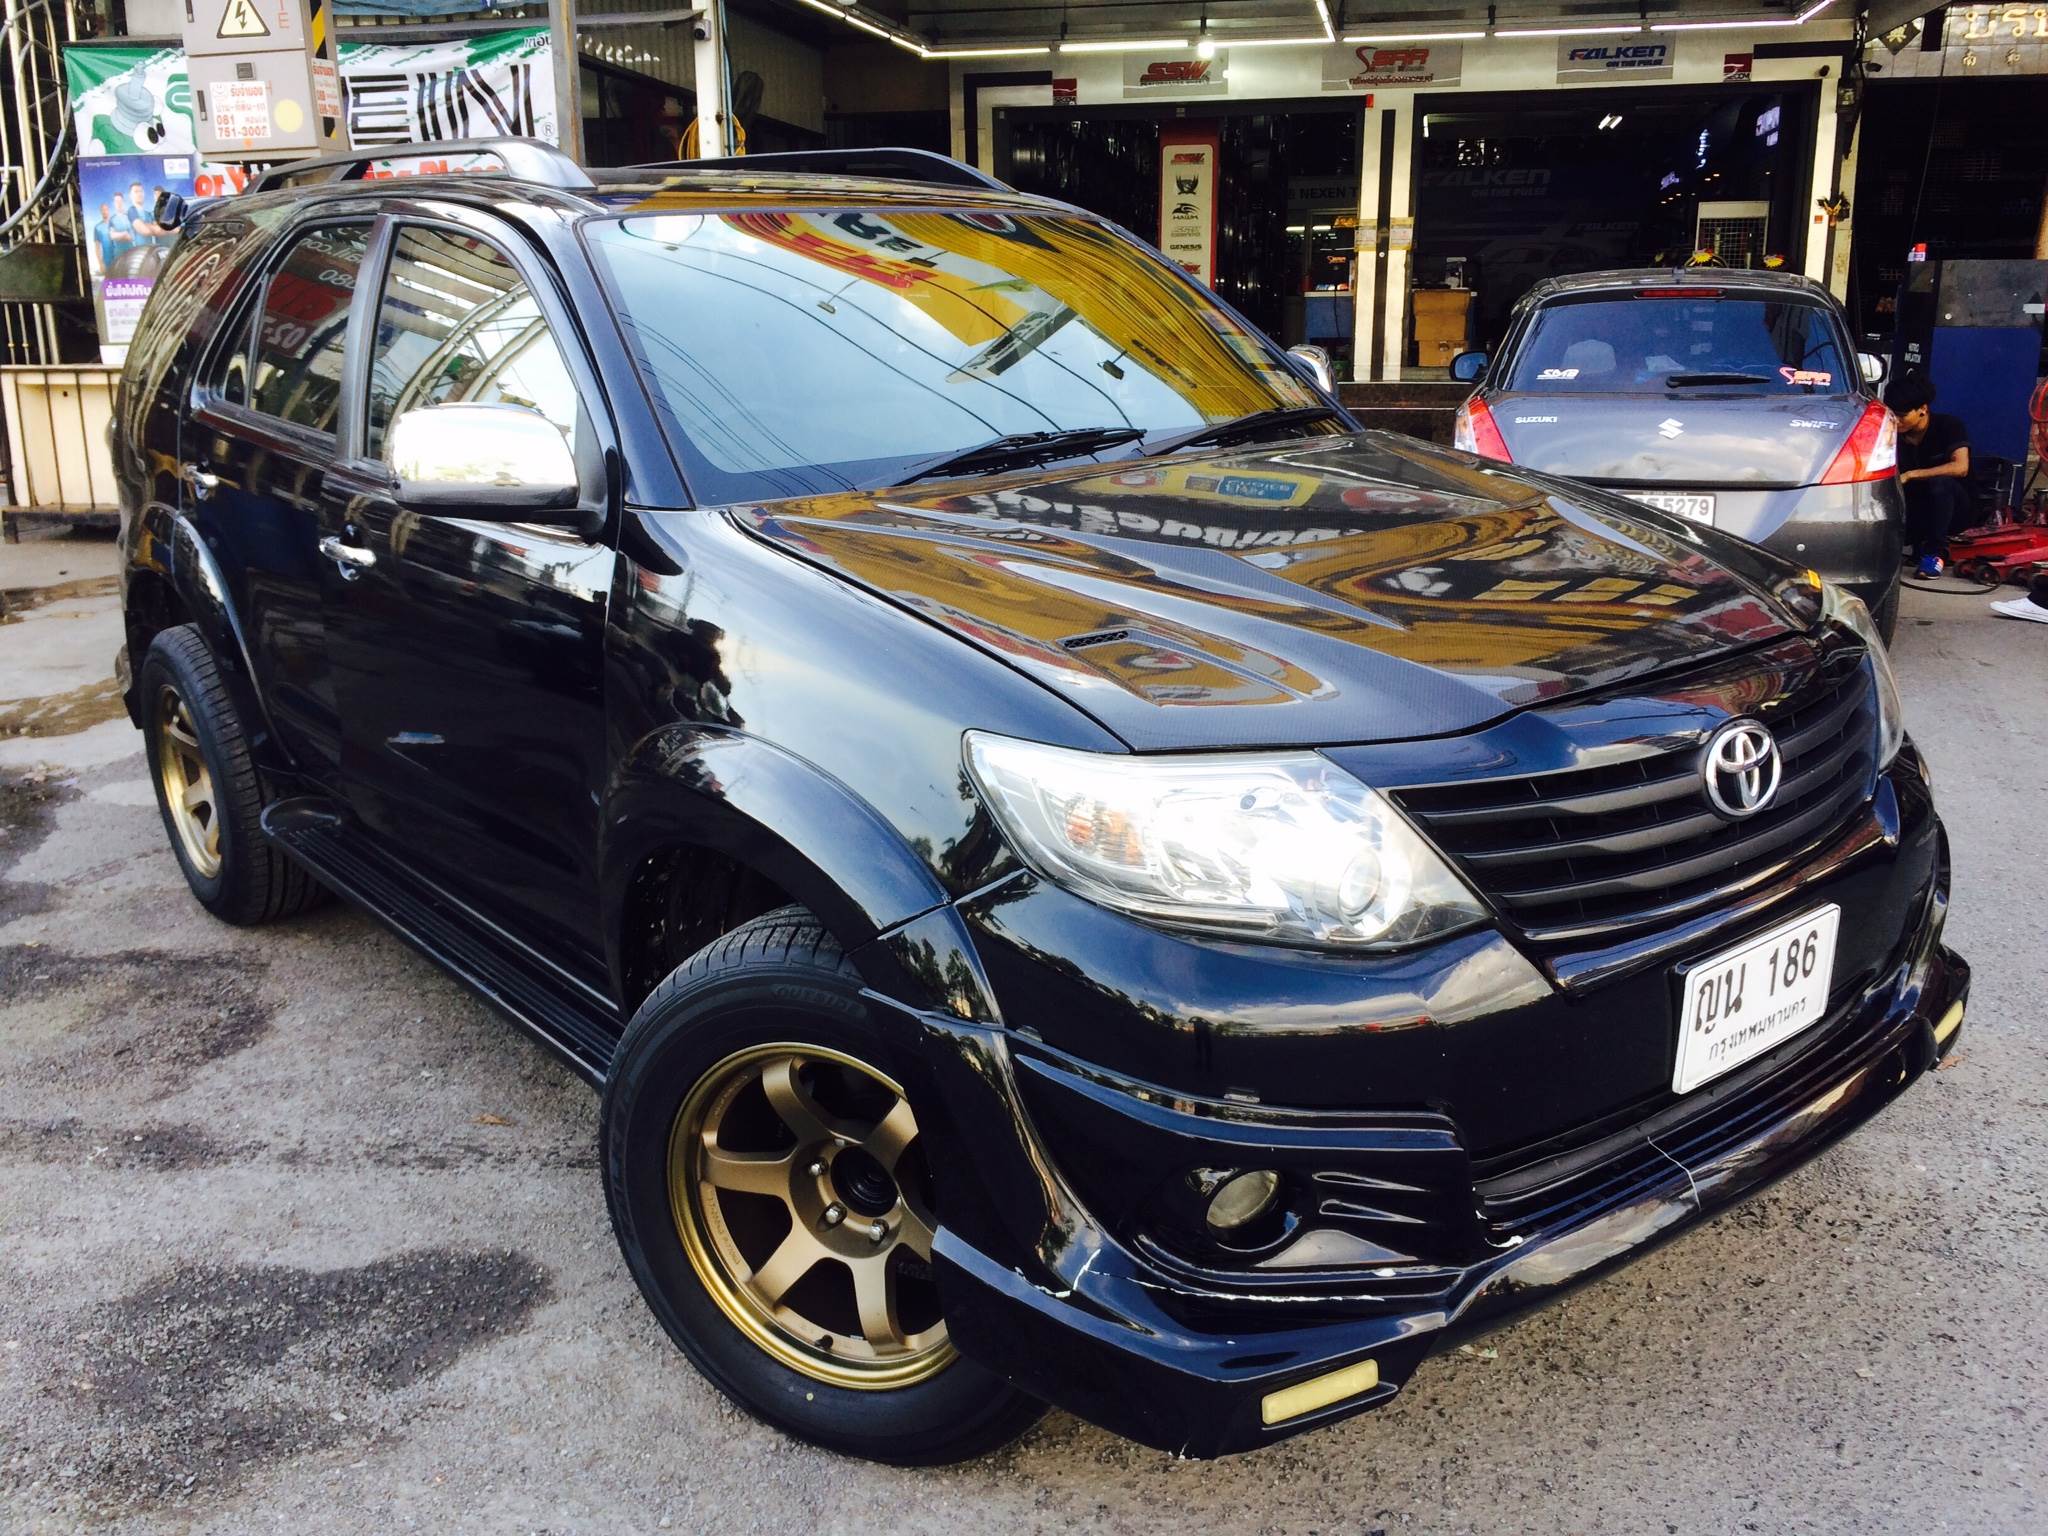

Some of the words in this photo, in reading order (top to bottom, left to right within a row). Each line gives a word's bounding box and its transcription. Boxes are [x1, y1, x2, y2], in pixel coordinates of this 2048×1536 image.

[1569, 45, 1667, 60] FALKEN
[216, 114, 235, 125] 081
[194, 173, 226, 197] or
[1300, 187, 1346, 200] NEXEN
[1515, 415, 1558, 424] SUZUKI
[1789, 419, 1839, 431] SWIFT
[1663, 497, 1710, 517] 5279
[1695, 963, 1747, 1036] ญน
[1769, 929, 1819, 997] 186
[1709, 996, 1807, 1061] กรุงเทพมหานคร
